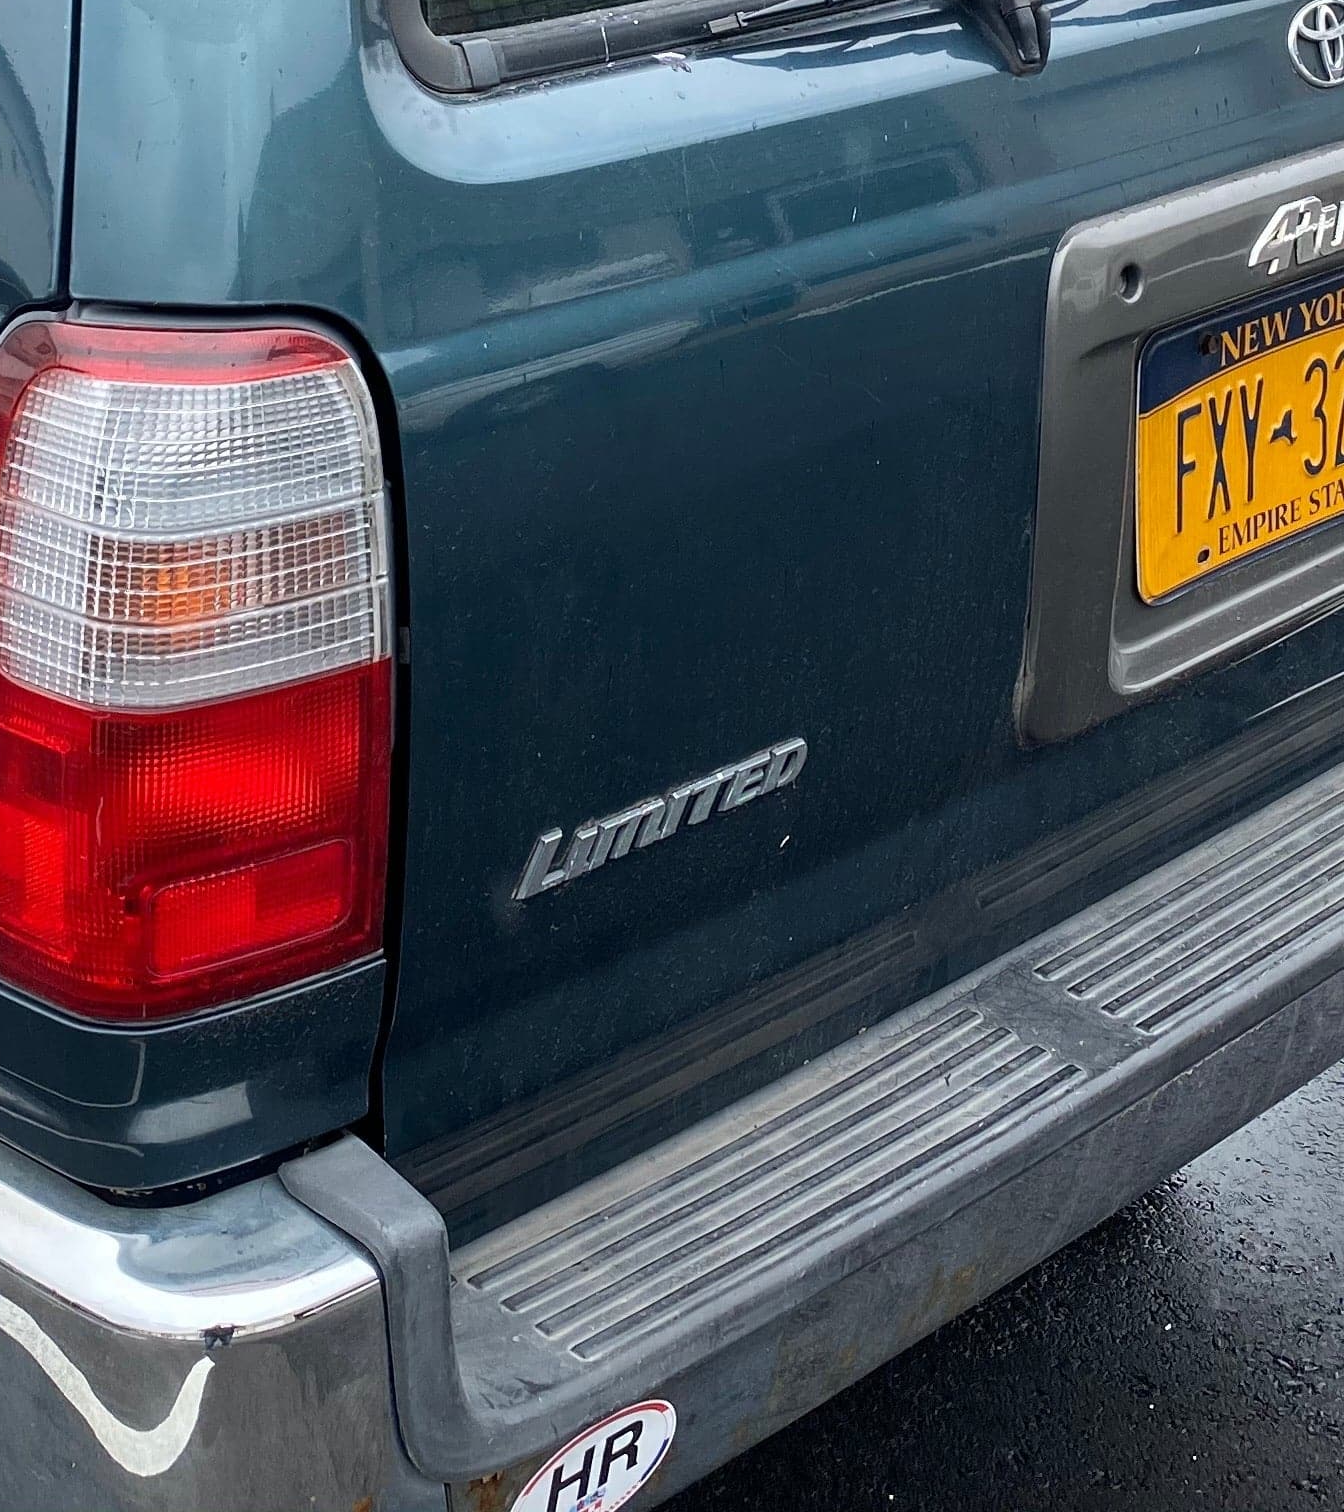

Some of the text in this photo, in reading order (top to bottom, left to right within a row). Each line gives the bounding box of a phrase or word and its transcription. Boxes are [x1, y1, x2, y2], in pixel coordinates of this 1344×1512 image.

[1219, 307, 1293, 368] NEW
[1175, 376, 1264, 535] FXY
[1217, 497, 1302, 556] EMPIRE
[510, 735, 809, 901] LIMITED
[545, 1419, 644, 1512] HR
